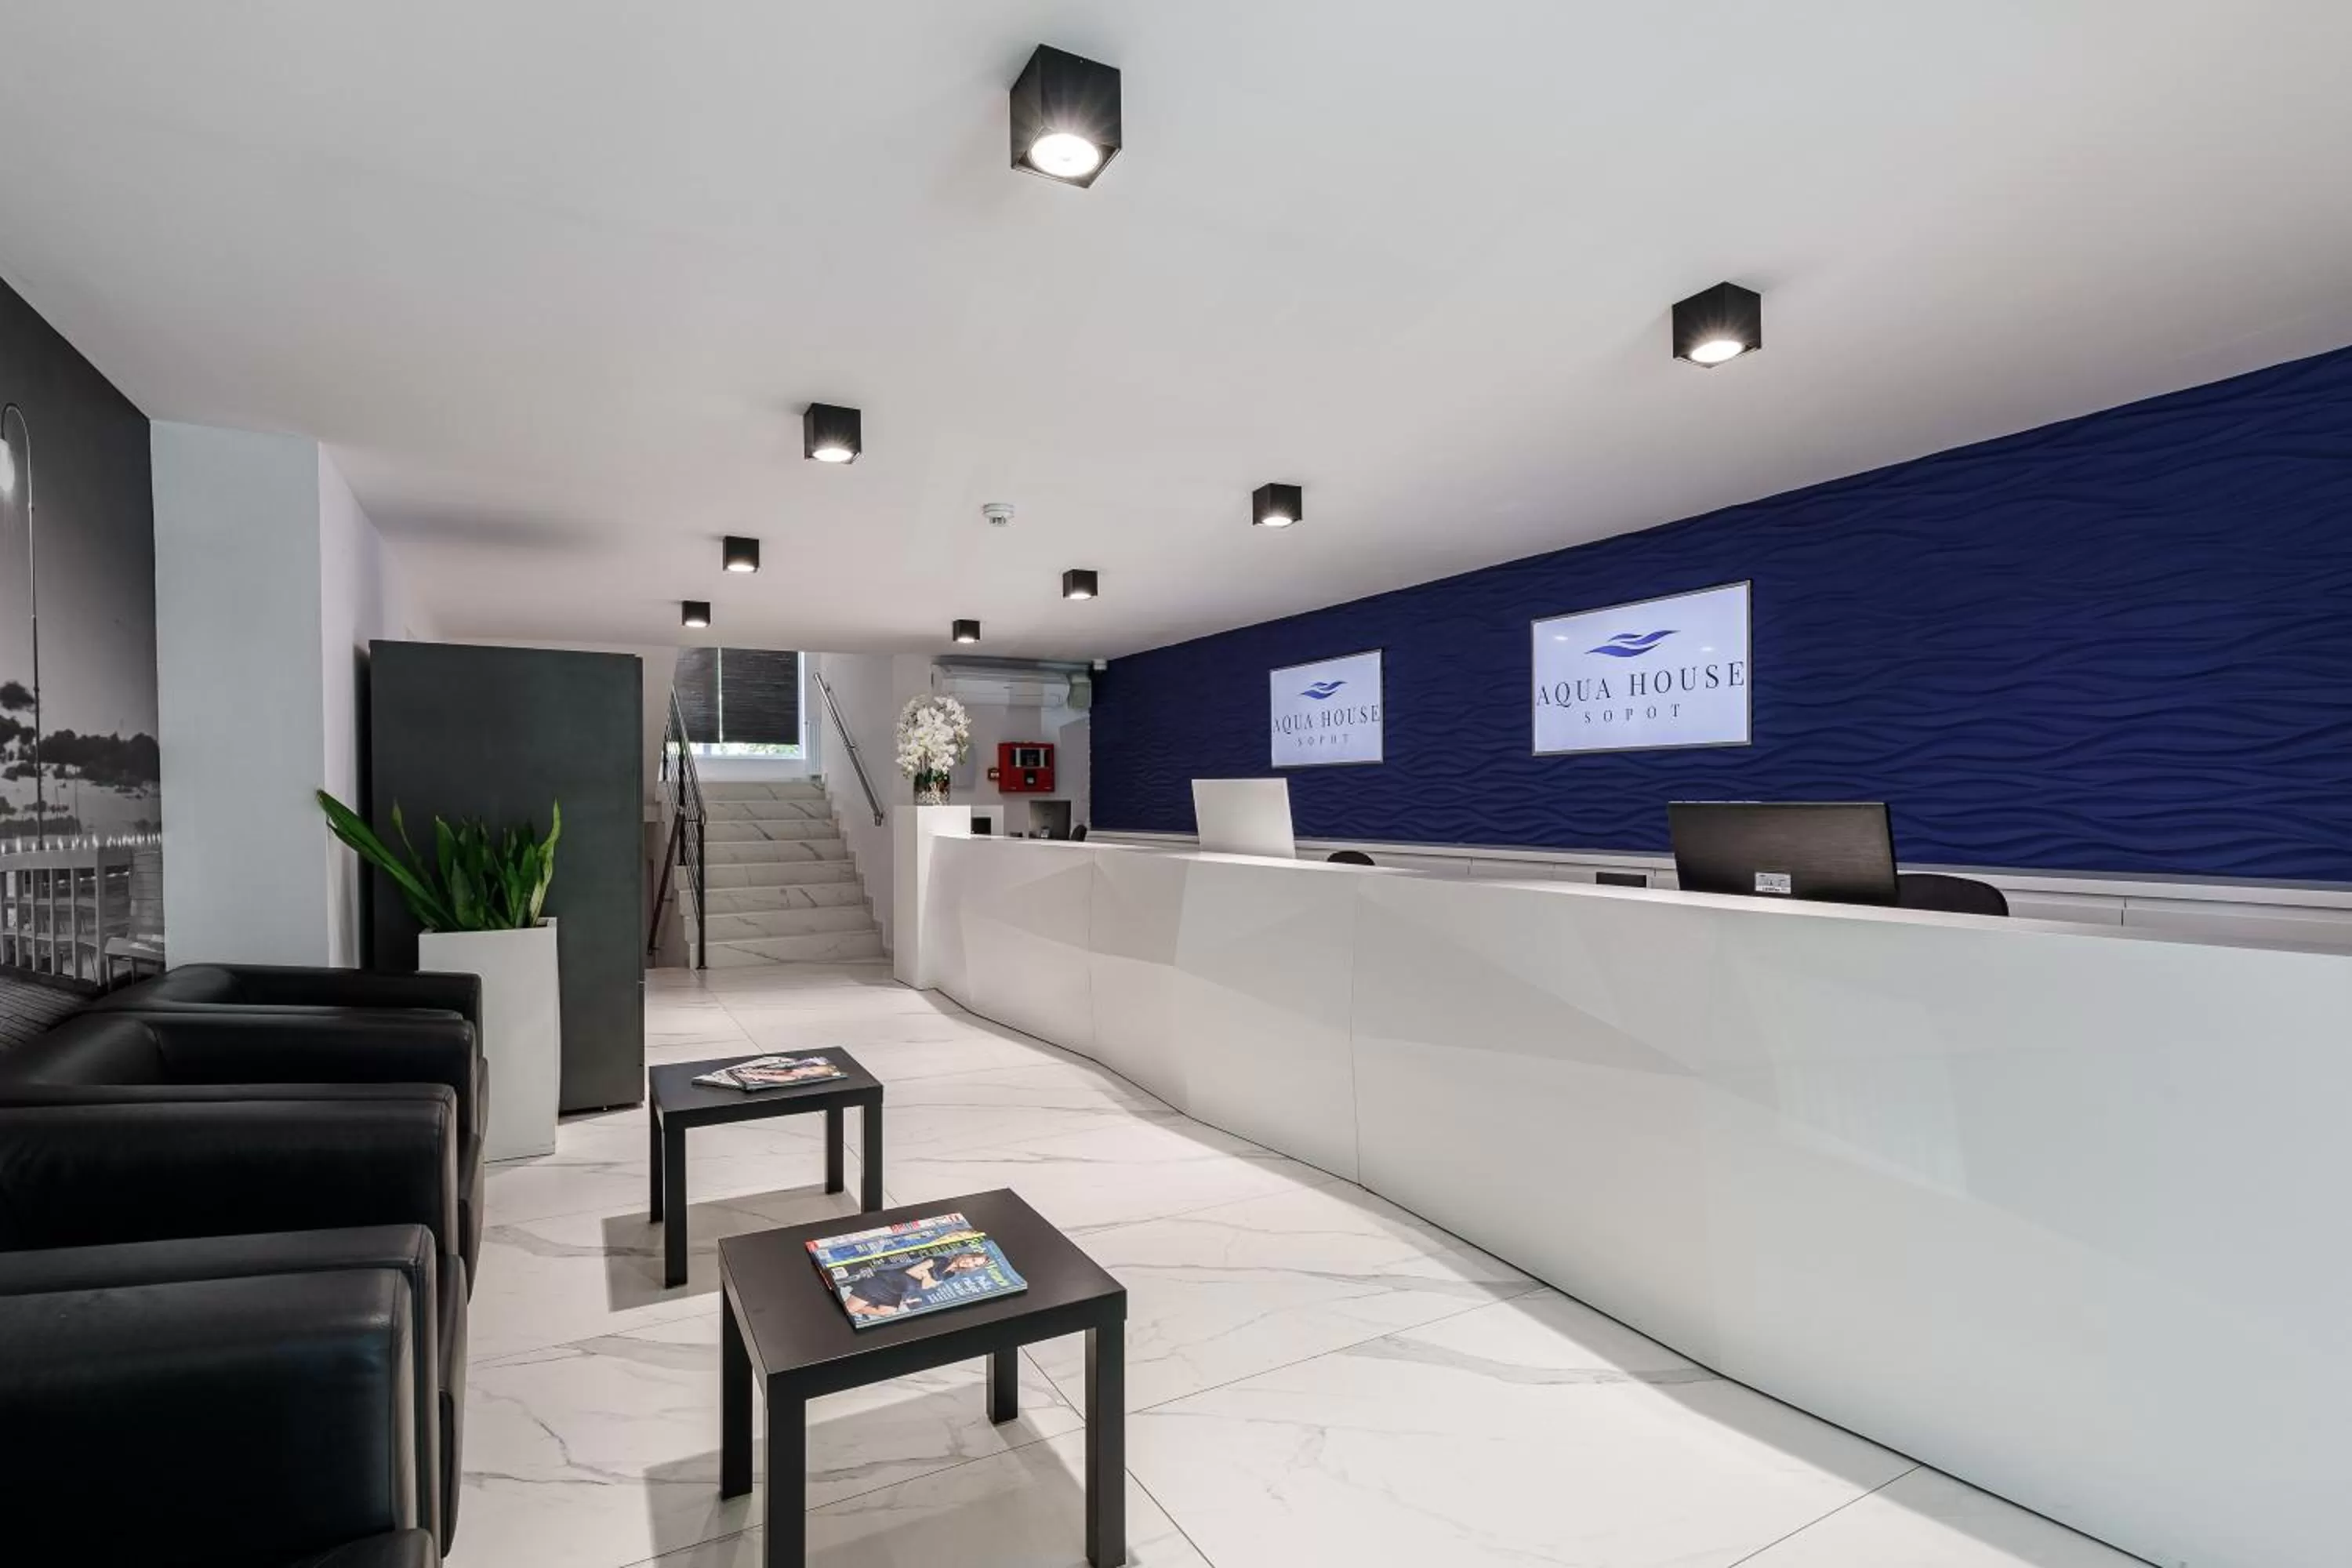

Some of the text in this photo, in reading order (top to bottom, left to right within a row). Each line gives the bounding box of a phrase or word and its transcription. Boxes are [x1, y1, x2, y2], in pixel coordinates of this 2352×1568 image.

[1536, 661, 1745, 708] AQUA HOUSE
[1272, 705, 1381, 735] AQUA HOUSE
[1584, 703, 1682, 724] SOPOT
